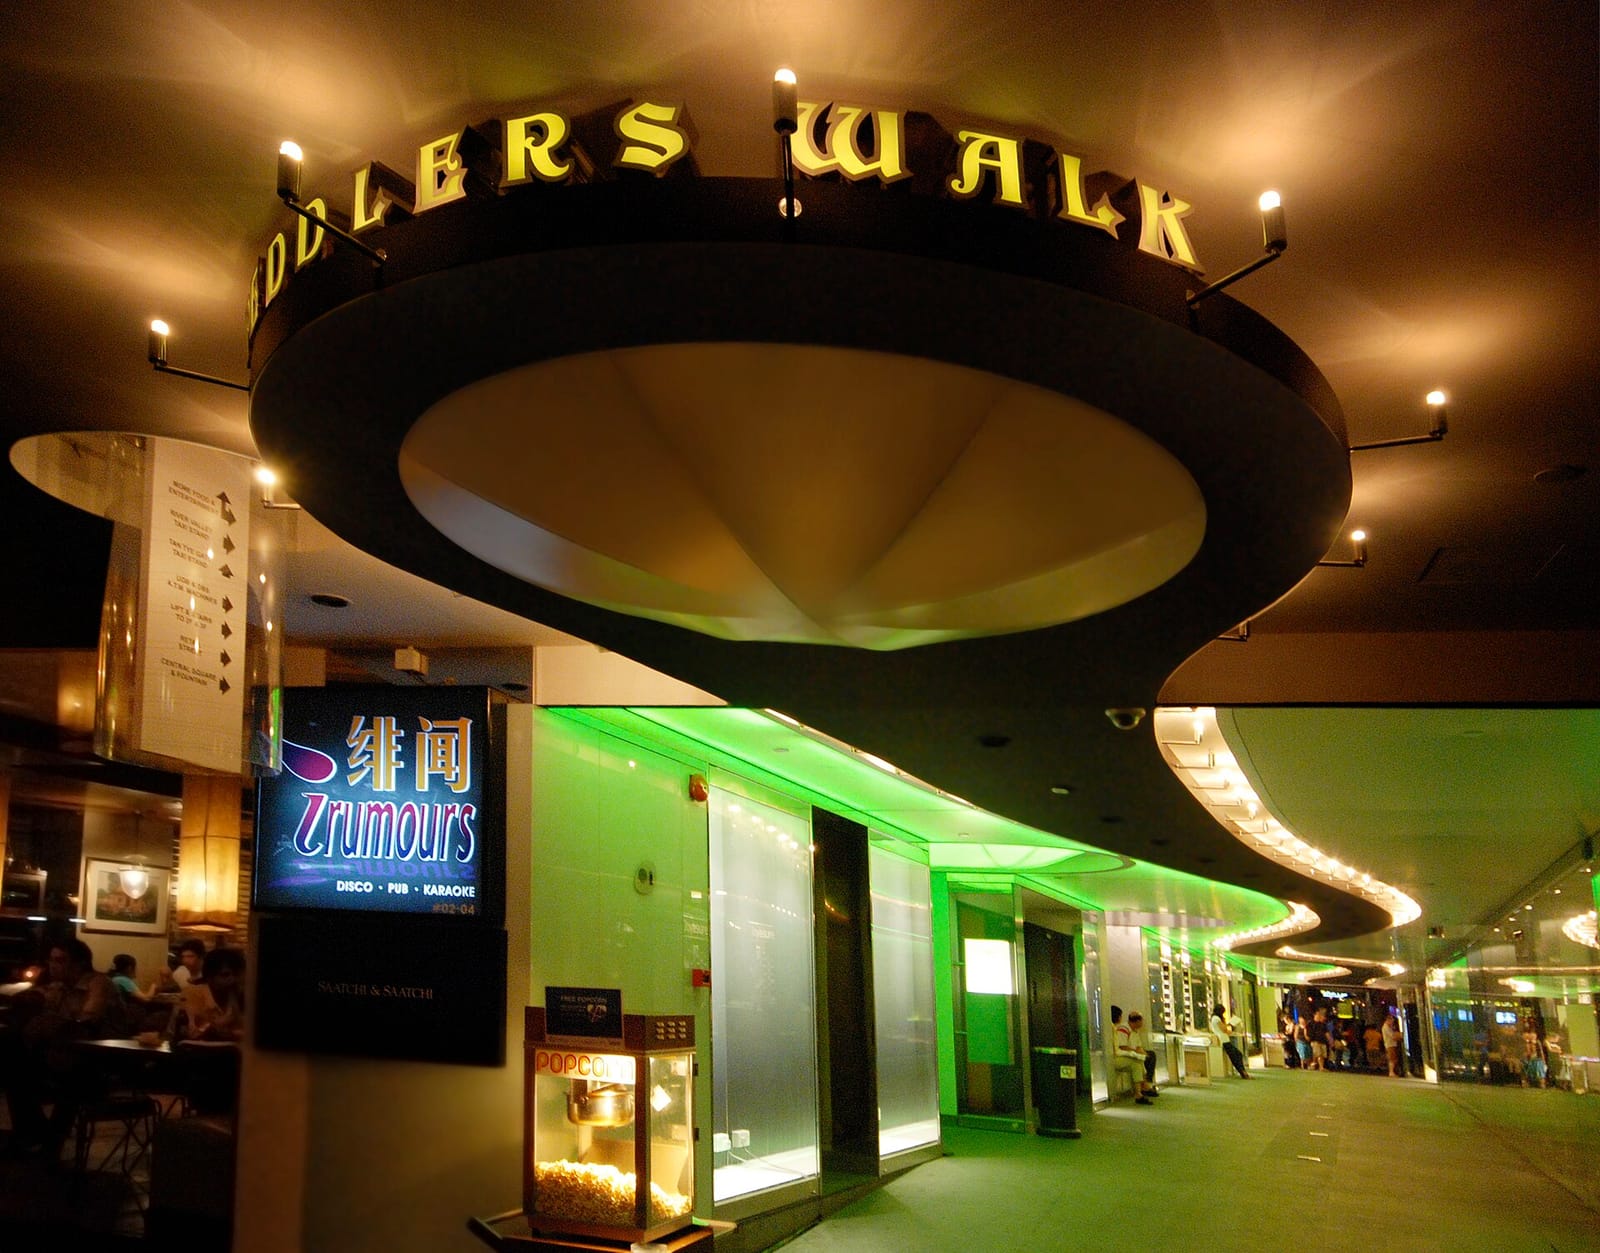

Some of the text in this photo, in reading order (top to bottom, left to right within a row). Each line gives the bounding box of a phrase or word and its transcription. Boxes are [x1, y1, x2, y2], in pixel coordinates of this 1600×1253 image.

[789, 100, 1204, 275] WALK
[346, 716, 473, 794] 绯闻
[336, 880, 476, 898] DISCO PUB KARAOKE
[432, 903, 476, 916] #02-04
[318, 981, 434, 1000] SAATCHI & SAATCHI
[536, 1051, 634, 1081] POPCO
